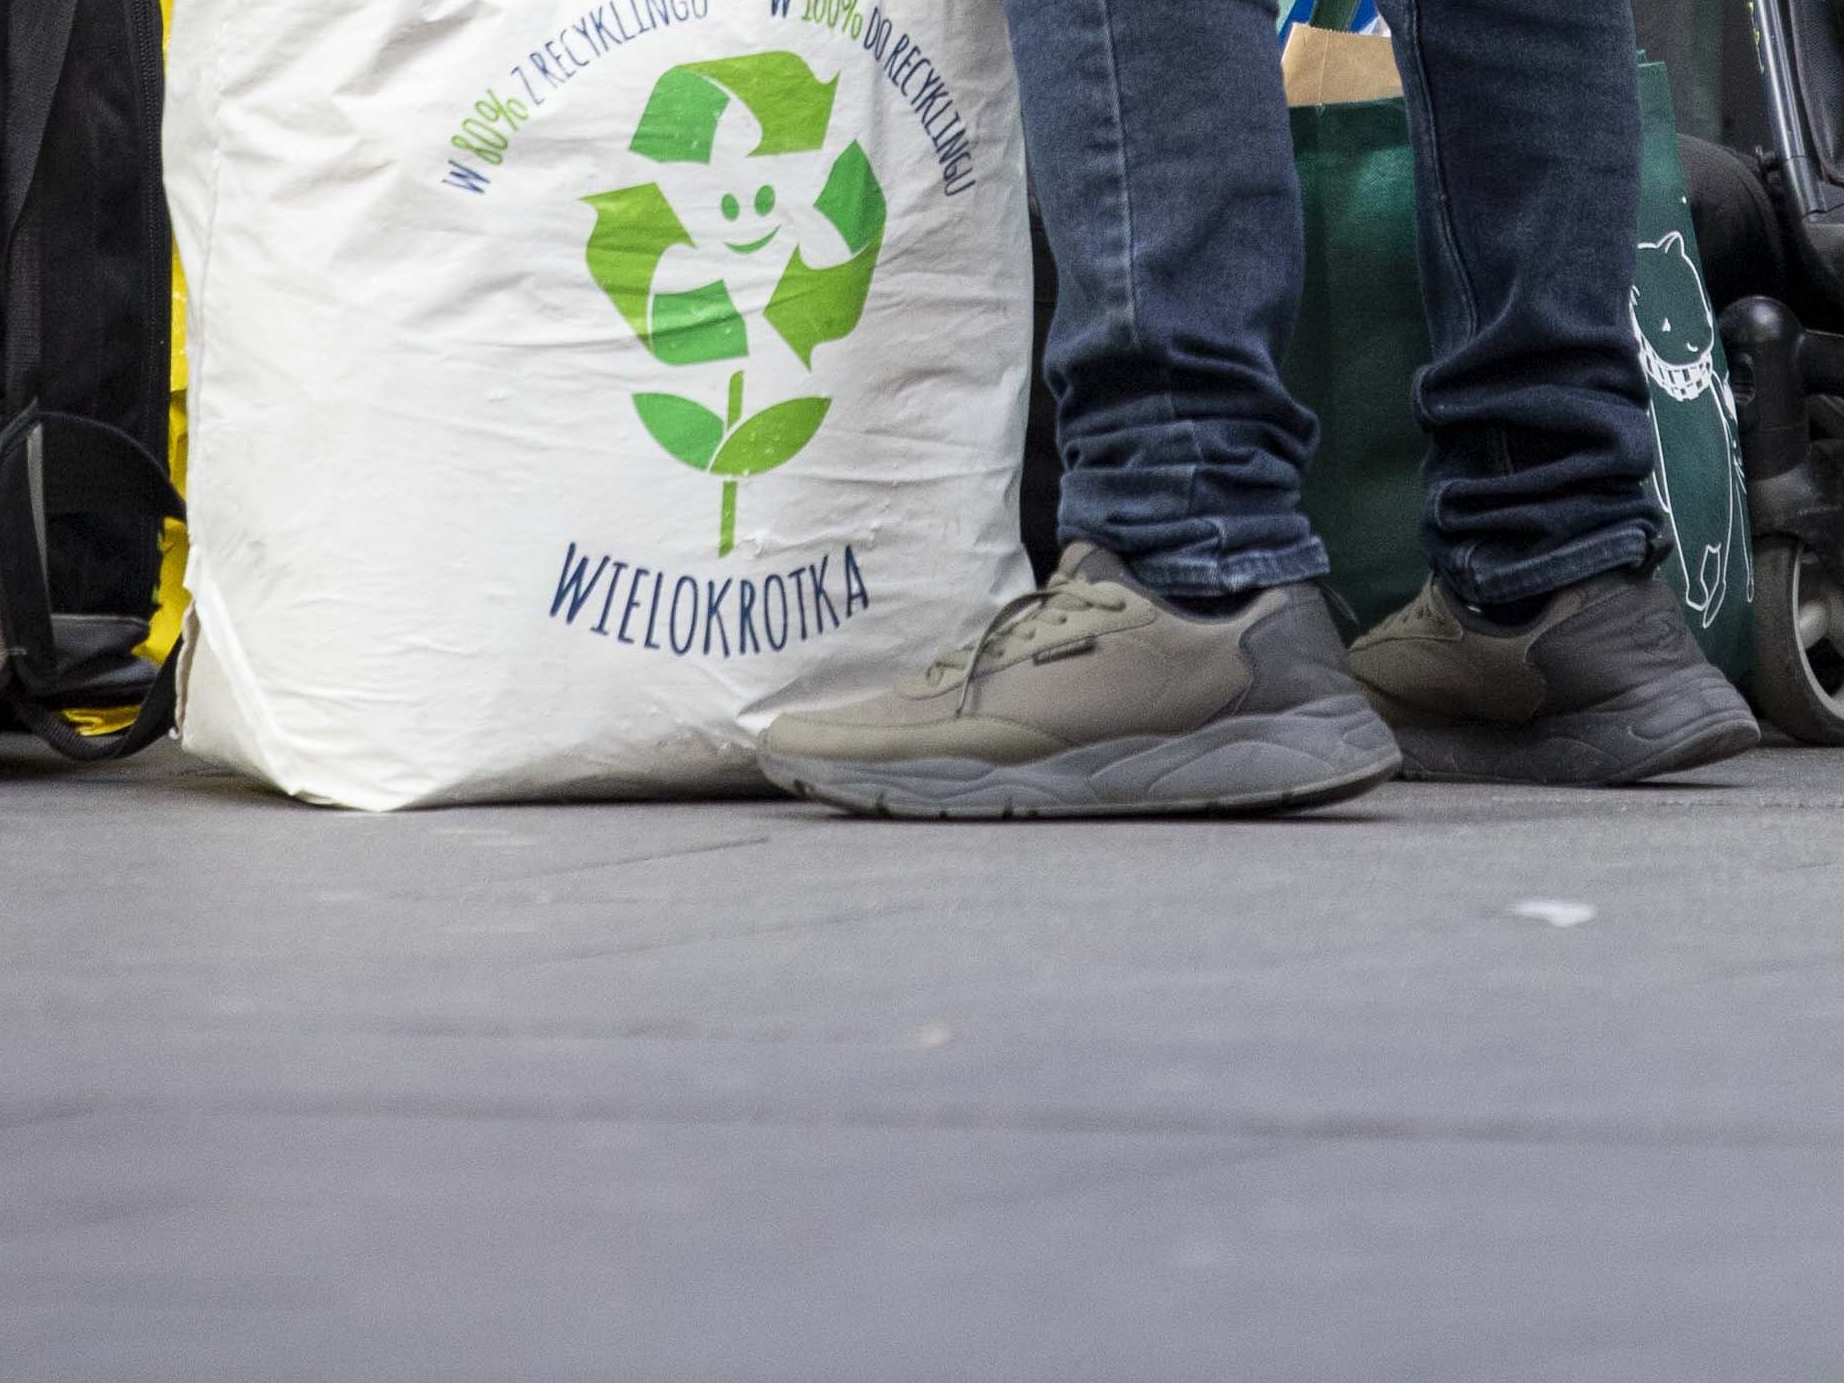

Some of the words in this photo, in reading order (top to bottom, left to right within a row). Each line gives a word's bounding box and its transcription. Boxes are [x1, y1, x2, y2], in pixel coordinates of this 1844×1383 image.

[510, 66, 544, 106] Z
[863, 6, 893, 62] DO
[883, 34, 976, 197] RECYKLINGU
[451, 88, 529, 166] 80%
[442, 159, 490, 194] W
[549, 541, 870, 659] WIELOKROTKA
